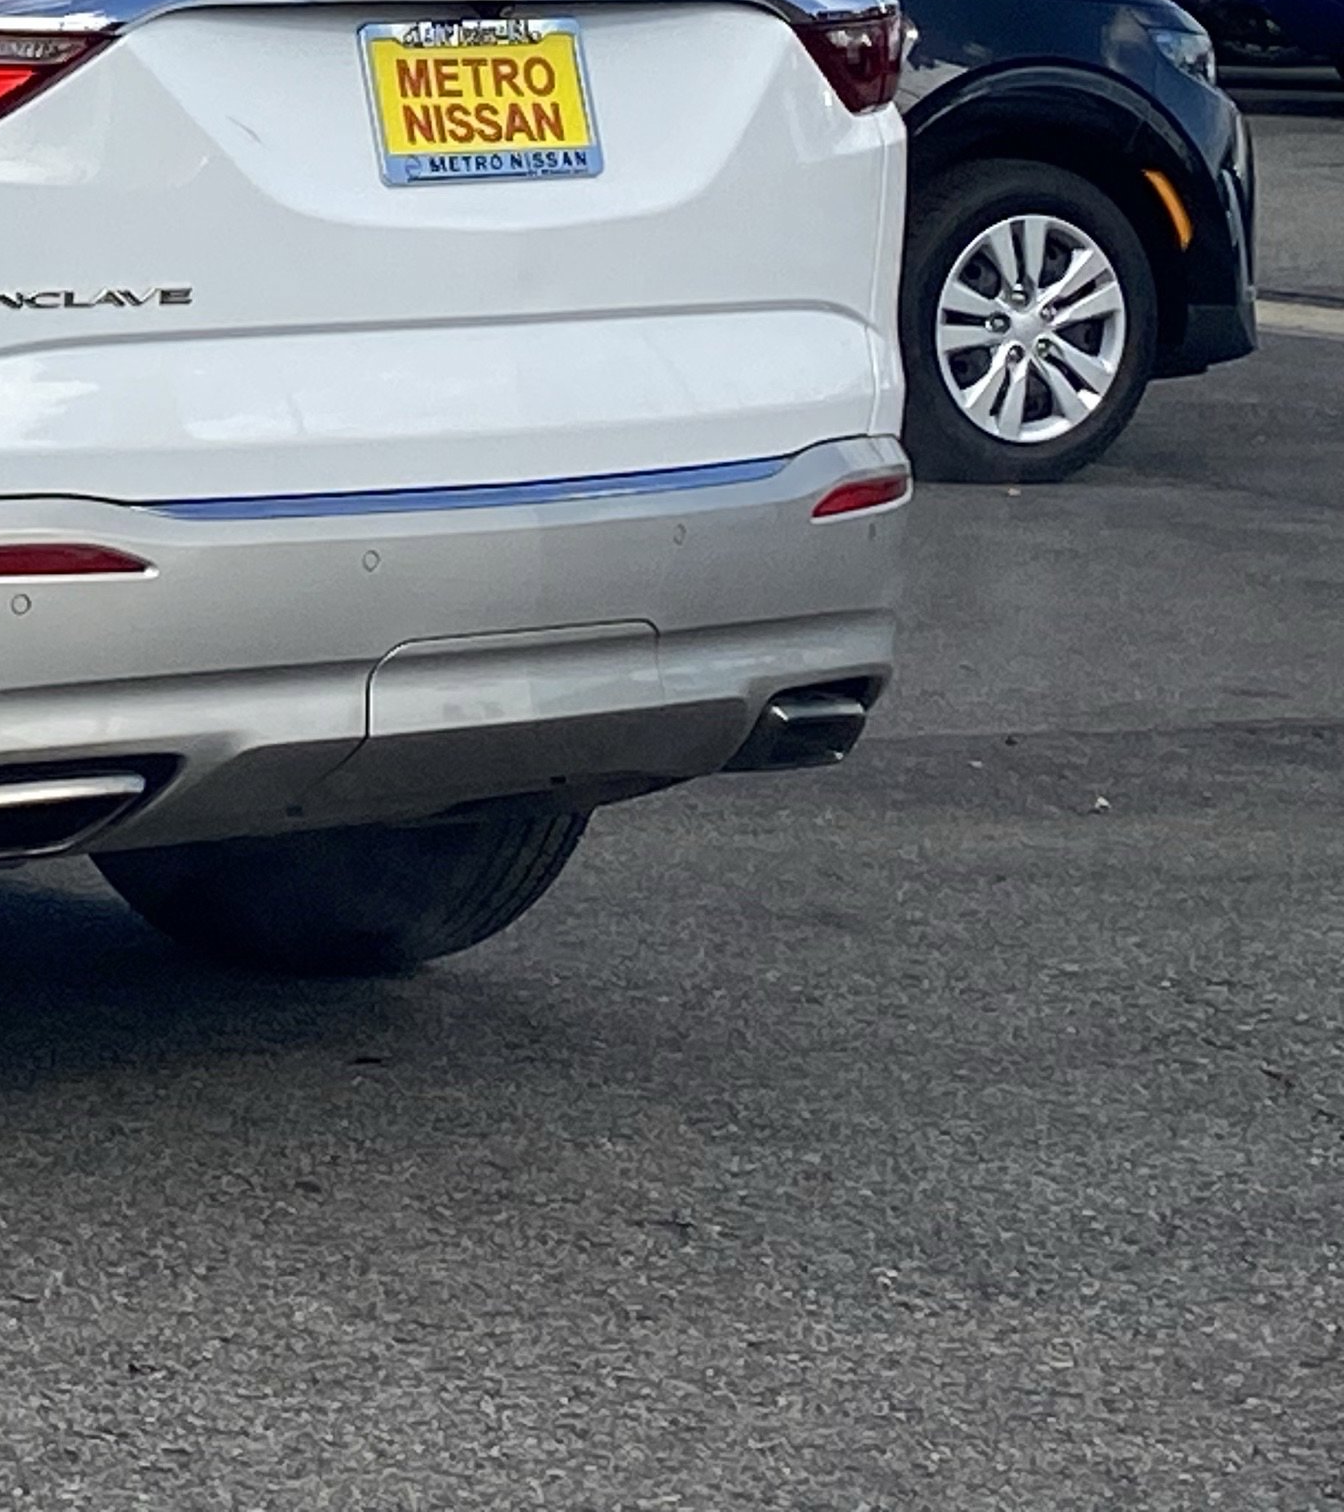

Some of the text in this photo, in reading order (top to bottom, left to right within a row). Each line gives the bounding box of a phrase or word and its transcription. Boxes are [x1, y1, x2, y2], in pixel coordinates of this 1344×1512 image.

[396, 56, 556, 99] METRO
[402, 101, 565, 145] NISSAN
[429, 151, 587, 173] METRO NISSAN
